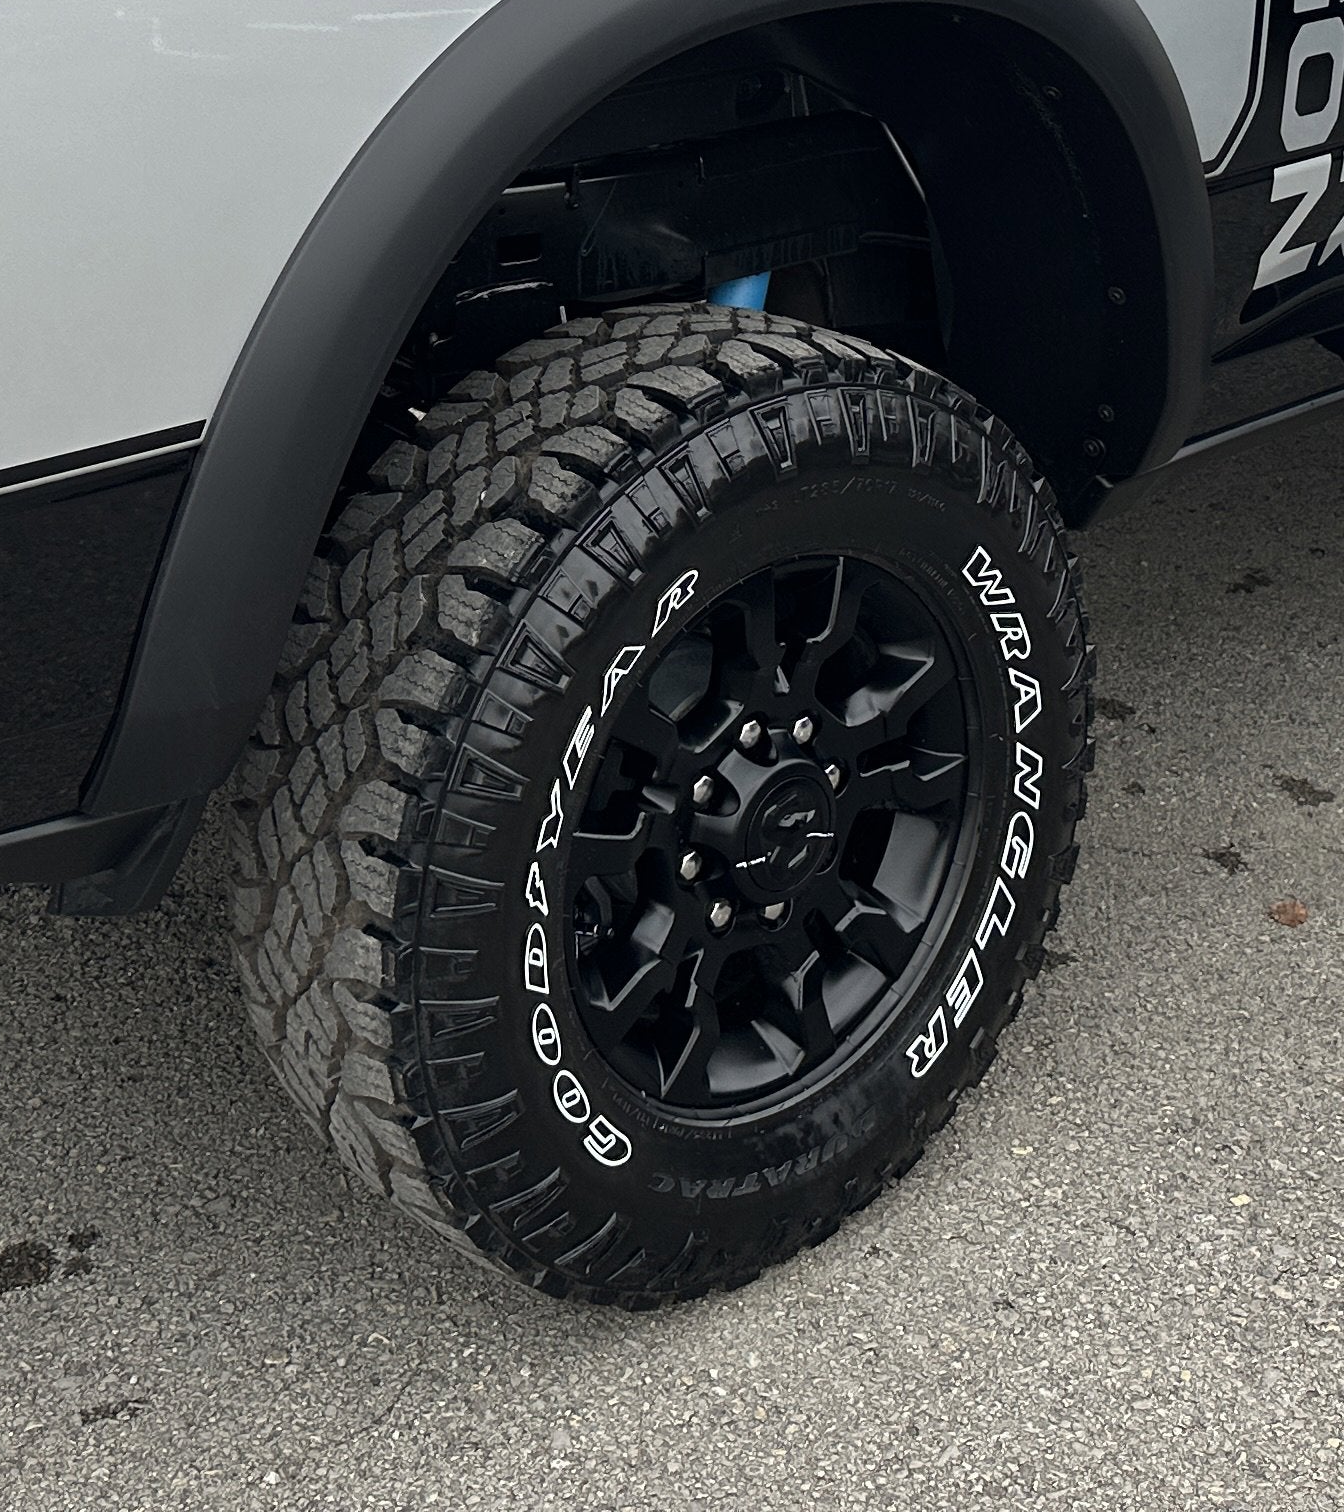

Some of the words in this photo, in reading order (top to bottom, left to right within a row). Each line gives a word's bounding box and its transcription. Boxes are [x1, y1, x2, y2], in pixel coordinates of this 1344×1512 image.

[524, 569, 699, 1167] GOODYEAR
[906, 545, 1044, 1078] WRANGLER
[647, 1104, 878, 1200] DURATRAC
